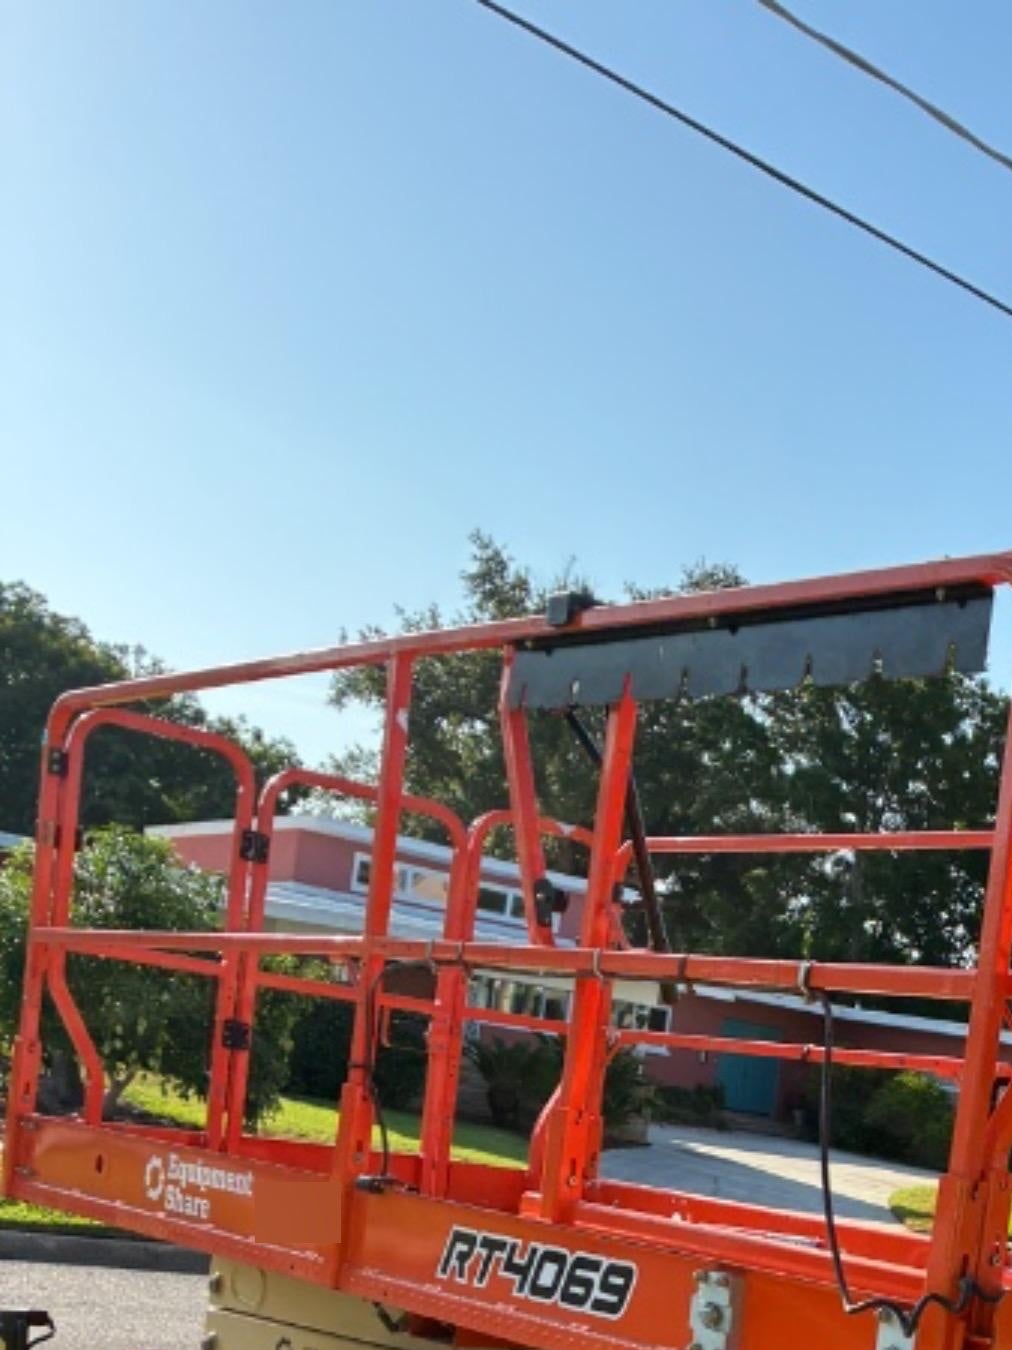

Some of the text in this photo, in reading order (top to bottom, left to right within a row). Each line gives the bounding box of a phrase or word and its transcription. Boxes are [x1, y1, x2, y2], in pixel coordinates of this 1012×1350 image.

[167, 1152, 253, 1197] Equipment
[164, 1184, 210, 1220] Share
[436, 1225, 637, 1320] RT4069
